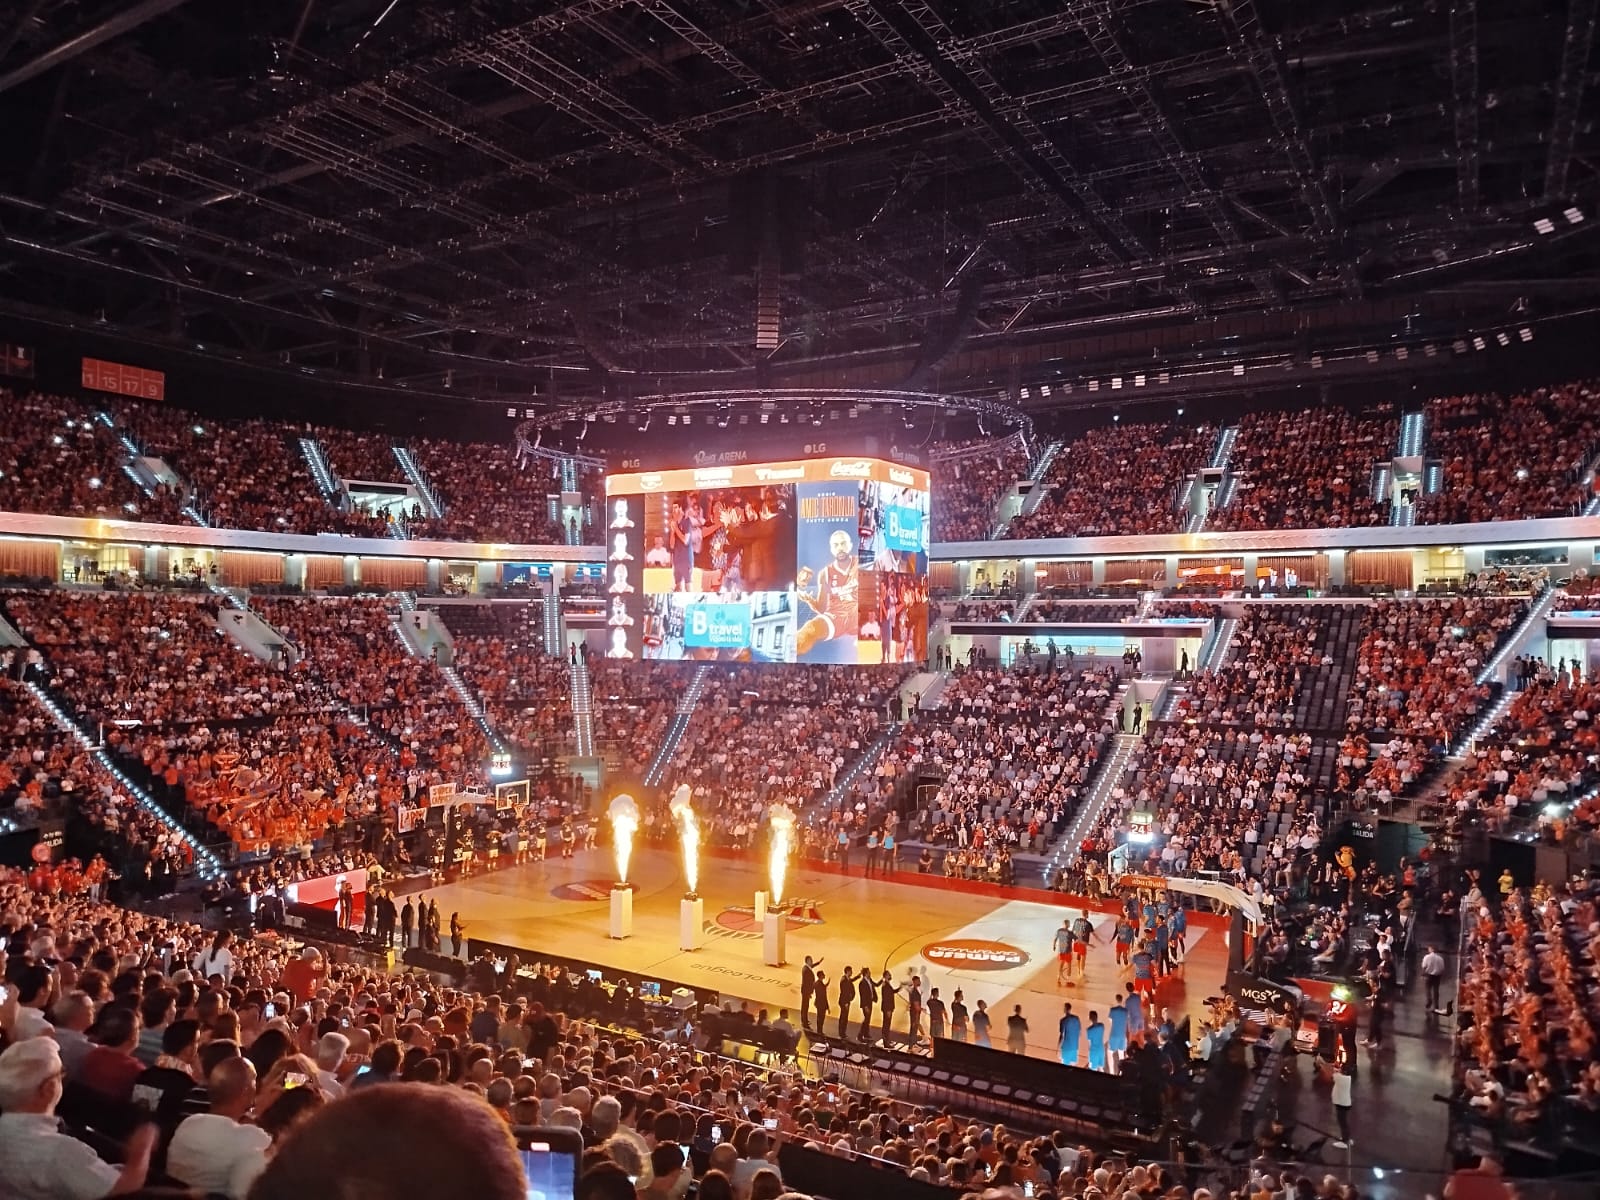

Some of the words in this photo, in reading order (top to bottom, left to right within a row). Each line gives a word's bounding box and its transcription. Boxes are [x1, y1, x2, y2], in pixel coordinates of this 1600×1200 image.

[102, 376, 118, 390] 15
[124, 381, 139, 393] 17
[149, 384, 158, 396] 9
[813, 443, 827, 453] LG
[718, 451, 747, 462] ARENA
[889, 511, 899, 537] B
[899, 527, 918, 540] travel
[692, 610, 708, 635] B
[708, 622, 743, 636] travel
[1131, 823, 1145, 834] 24
[254, 841, 271, 857] 19
[928, 950, 1021, 963] PAMESA
[690, 963, 793, 988] EuroLeague
[1241, 987, 1267, 1001] MGS
